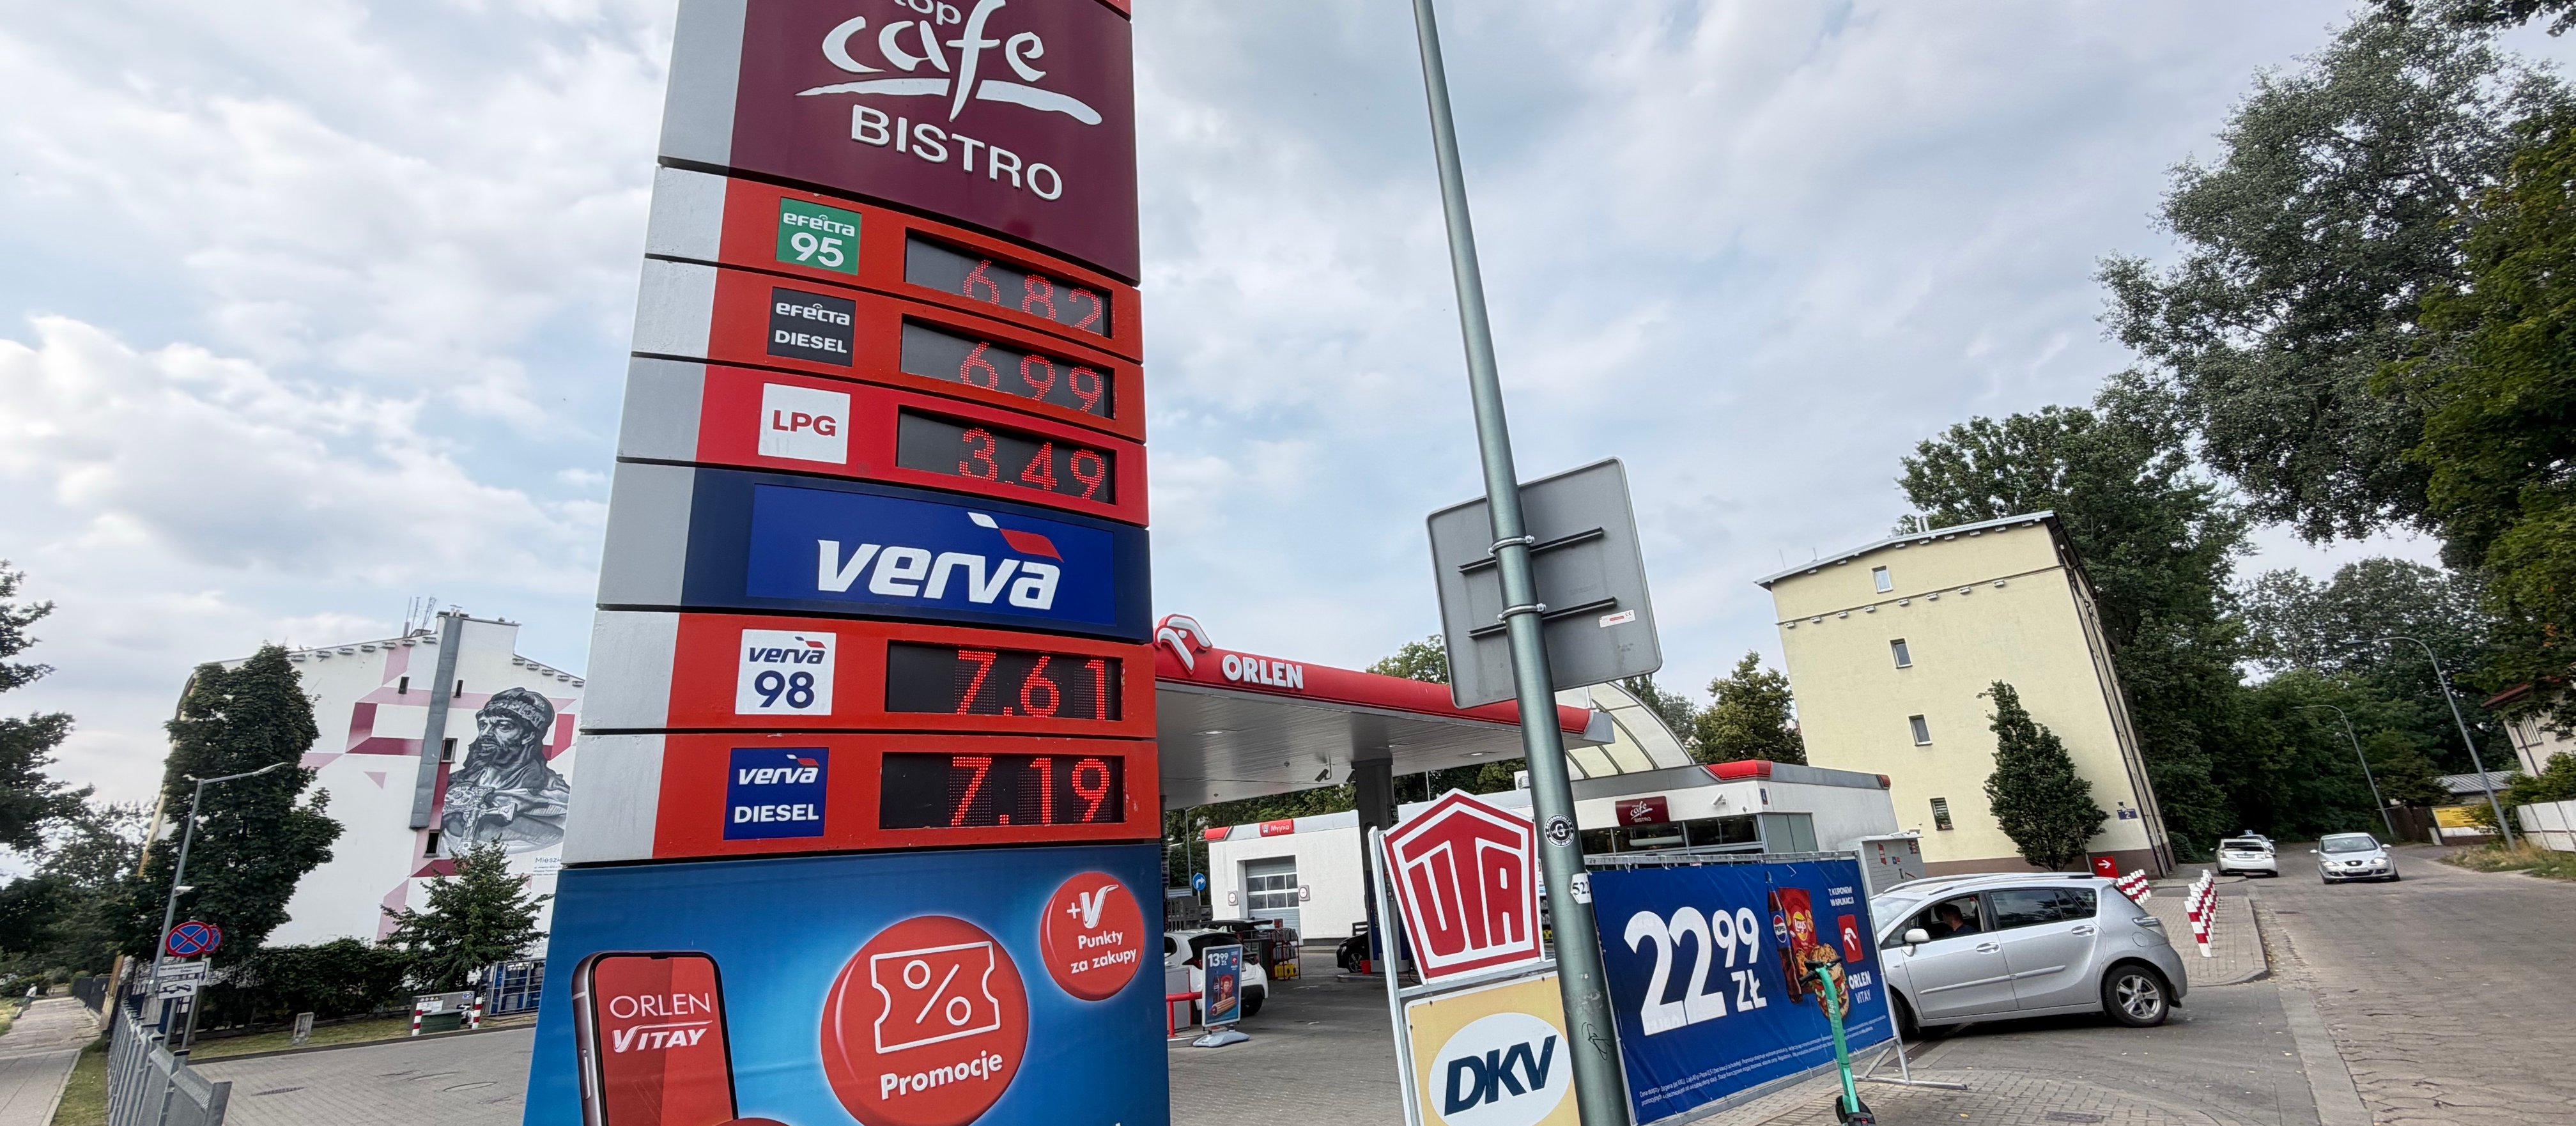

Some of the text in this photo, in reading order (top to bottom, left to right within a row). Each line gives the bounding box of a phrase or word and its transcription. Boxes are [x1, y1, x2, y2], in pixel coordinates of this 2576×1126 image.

[822, 0, 1046, 121] cafe
[851, 104, 1063, 201] BISTRO
[783, 212, 855, 237] efecta
[791, 232, 844, 267] 95
[776, 302, 850, 326] efecta
[775, 329, 847, 354] DIESEL
[772, 410, 837, 437] LPG
[817, 539, 1061, 610] verva
[749, 646, 826, 665] verva
[957, 649, 1106, 720] 7.61
[1222, 654, 1304, 690] ORLEN
[754, 670, 815, 708] 98
[739, 767, 819, 786] verva
[951, 756, 1110, 826] 7.19
[734, 803, 819, 824] DIESEL
[1555, 823, 1566, 837] G
[1401, 810, 1526, 957] UTA
[1077, 930, 1123, 950] Punkty
[1070, 948, 1138, 975] za zakupy
[1731, 969, 1768, 1013] ZŁ
[1848, 970, 1872, 990] ORLEN
[609, 992, 711, 1019] ORLEN
[1855, 989, 1872, 1004] VITAY
[612, 1020, 713, 1053] VITAY
[880, 1049, 1003, 1100] Promocje
[1444, 1035, 1557, 1117] DKV
